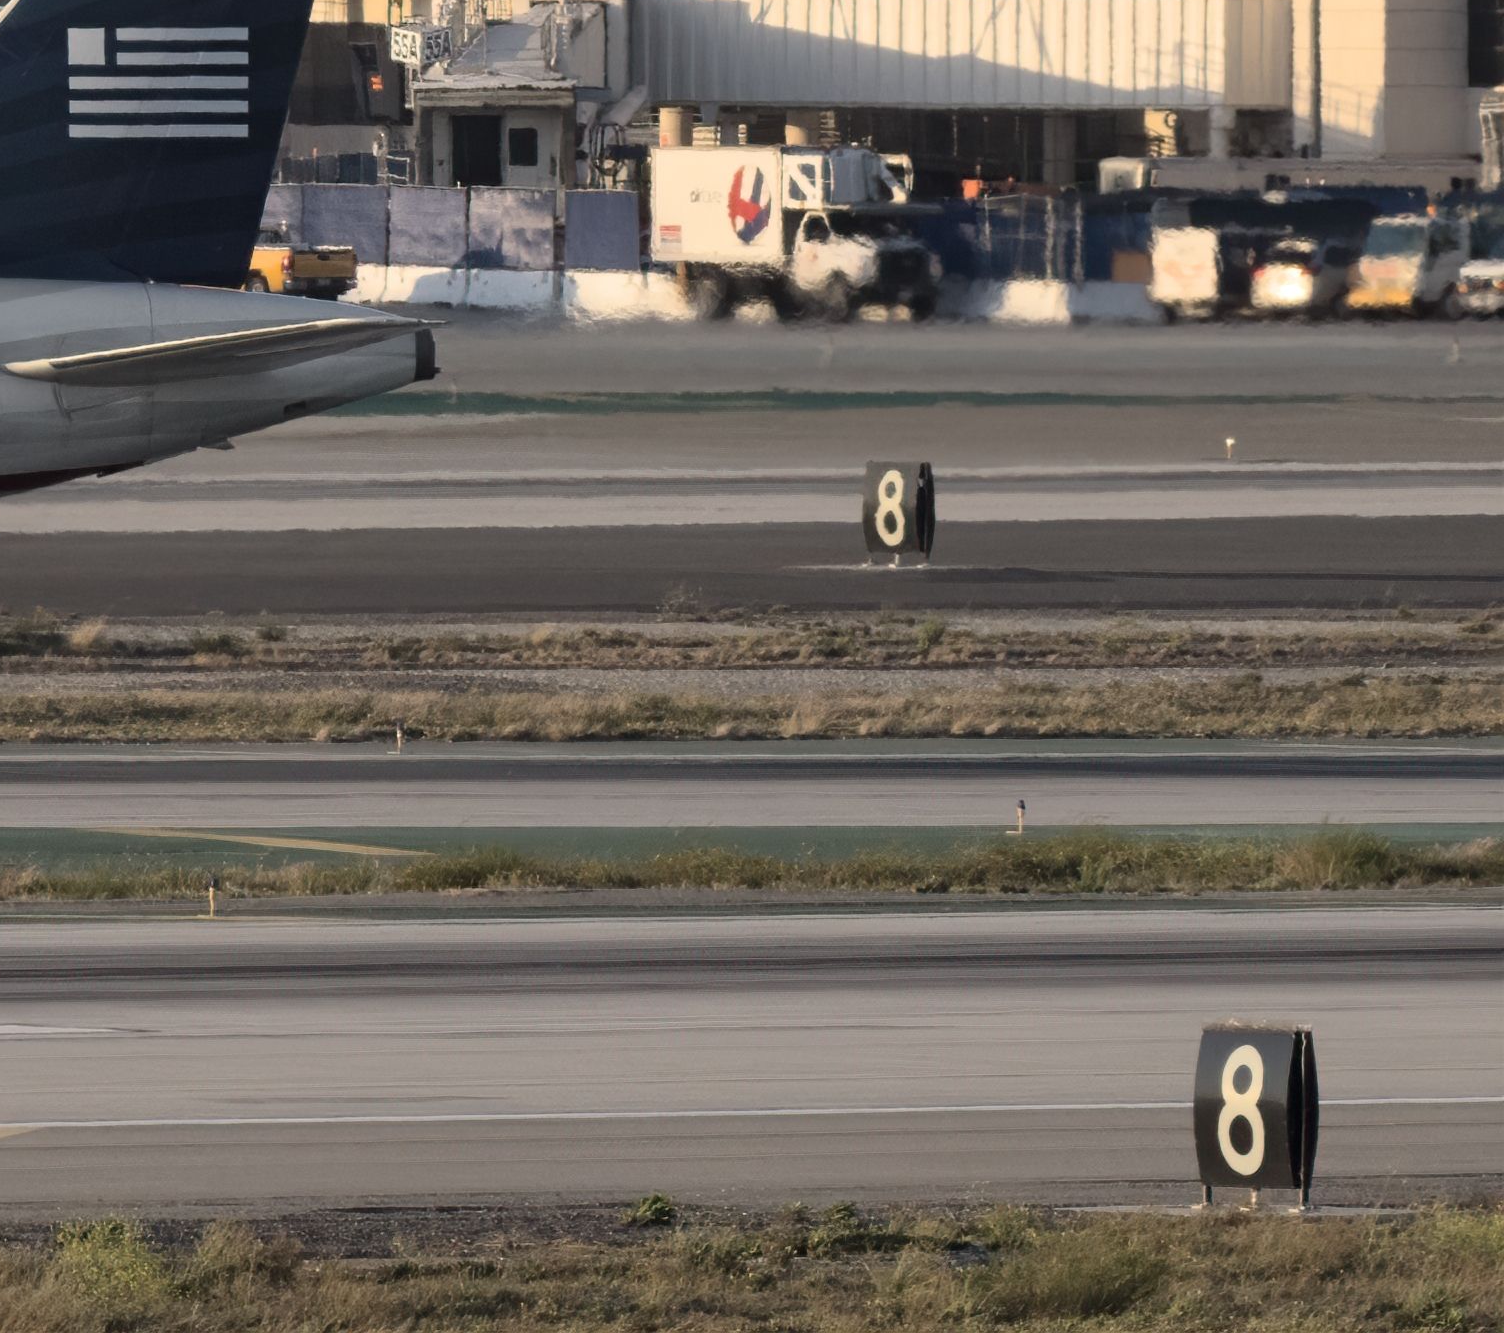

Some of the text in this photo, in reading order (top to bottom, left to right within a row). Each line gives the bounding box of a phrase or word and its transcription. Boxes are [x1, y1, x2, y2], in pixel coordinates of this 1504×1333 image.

[393, 31, 418, 60] 55A
[425, 30, 451, 61] 55A
[874, 469, 906, 547] 8
[1216, 1043, 1265, 1177] 8
